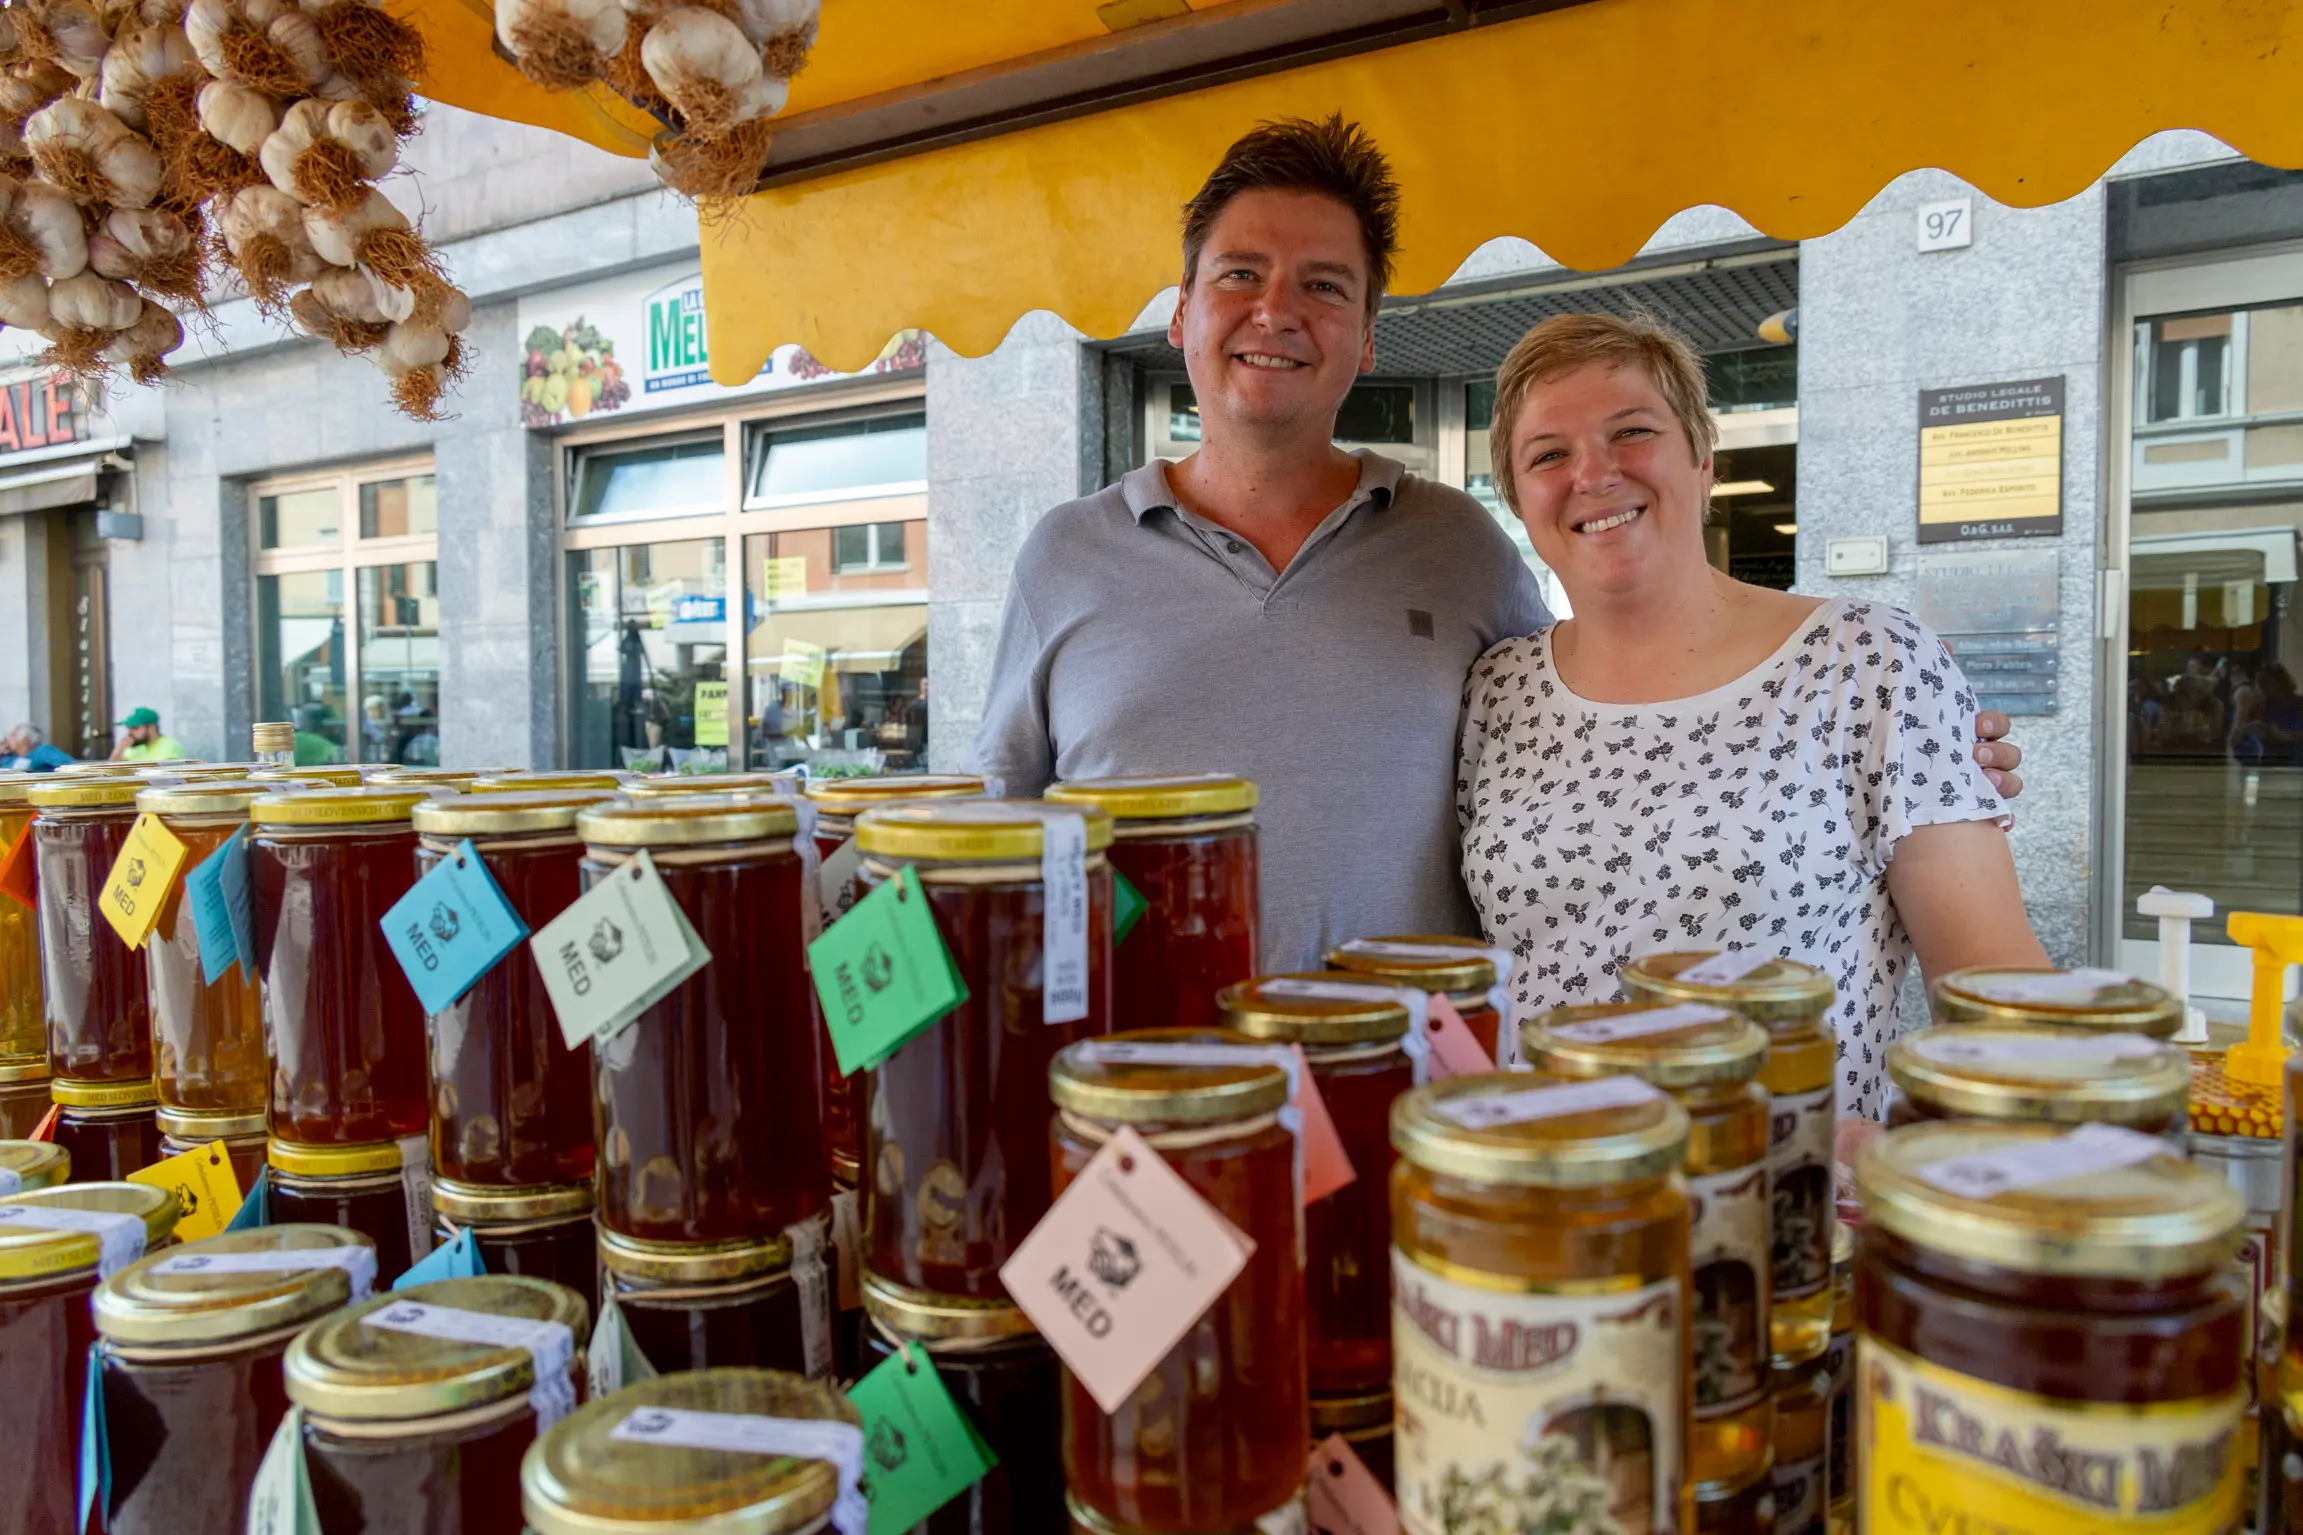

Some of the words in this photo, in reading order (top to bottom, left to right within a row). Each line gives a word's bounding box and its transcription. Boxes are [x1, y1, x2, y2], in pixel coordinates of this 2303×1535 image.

[1926, 208, 1964, 240] 97
[1929, 405, 1951, 416] DE
[1955, 395, 2052, 414] BENEDITTIS
[1938, 390, 1987, 403] STUDIO
[1991, 384, 2042, 398] LEGALE
[113, 884, 135, 916] MED
[405, 921, 439, 972] MED
[558, 940, 592, 997] MED
[833, 962, 865, 1026] MED
[1049, 1264, 1114, 1339] MED
